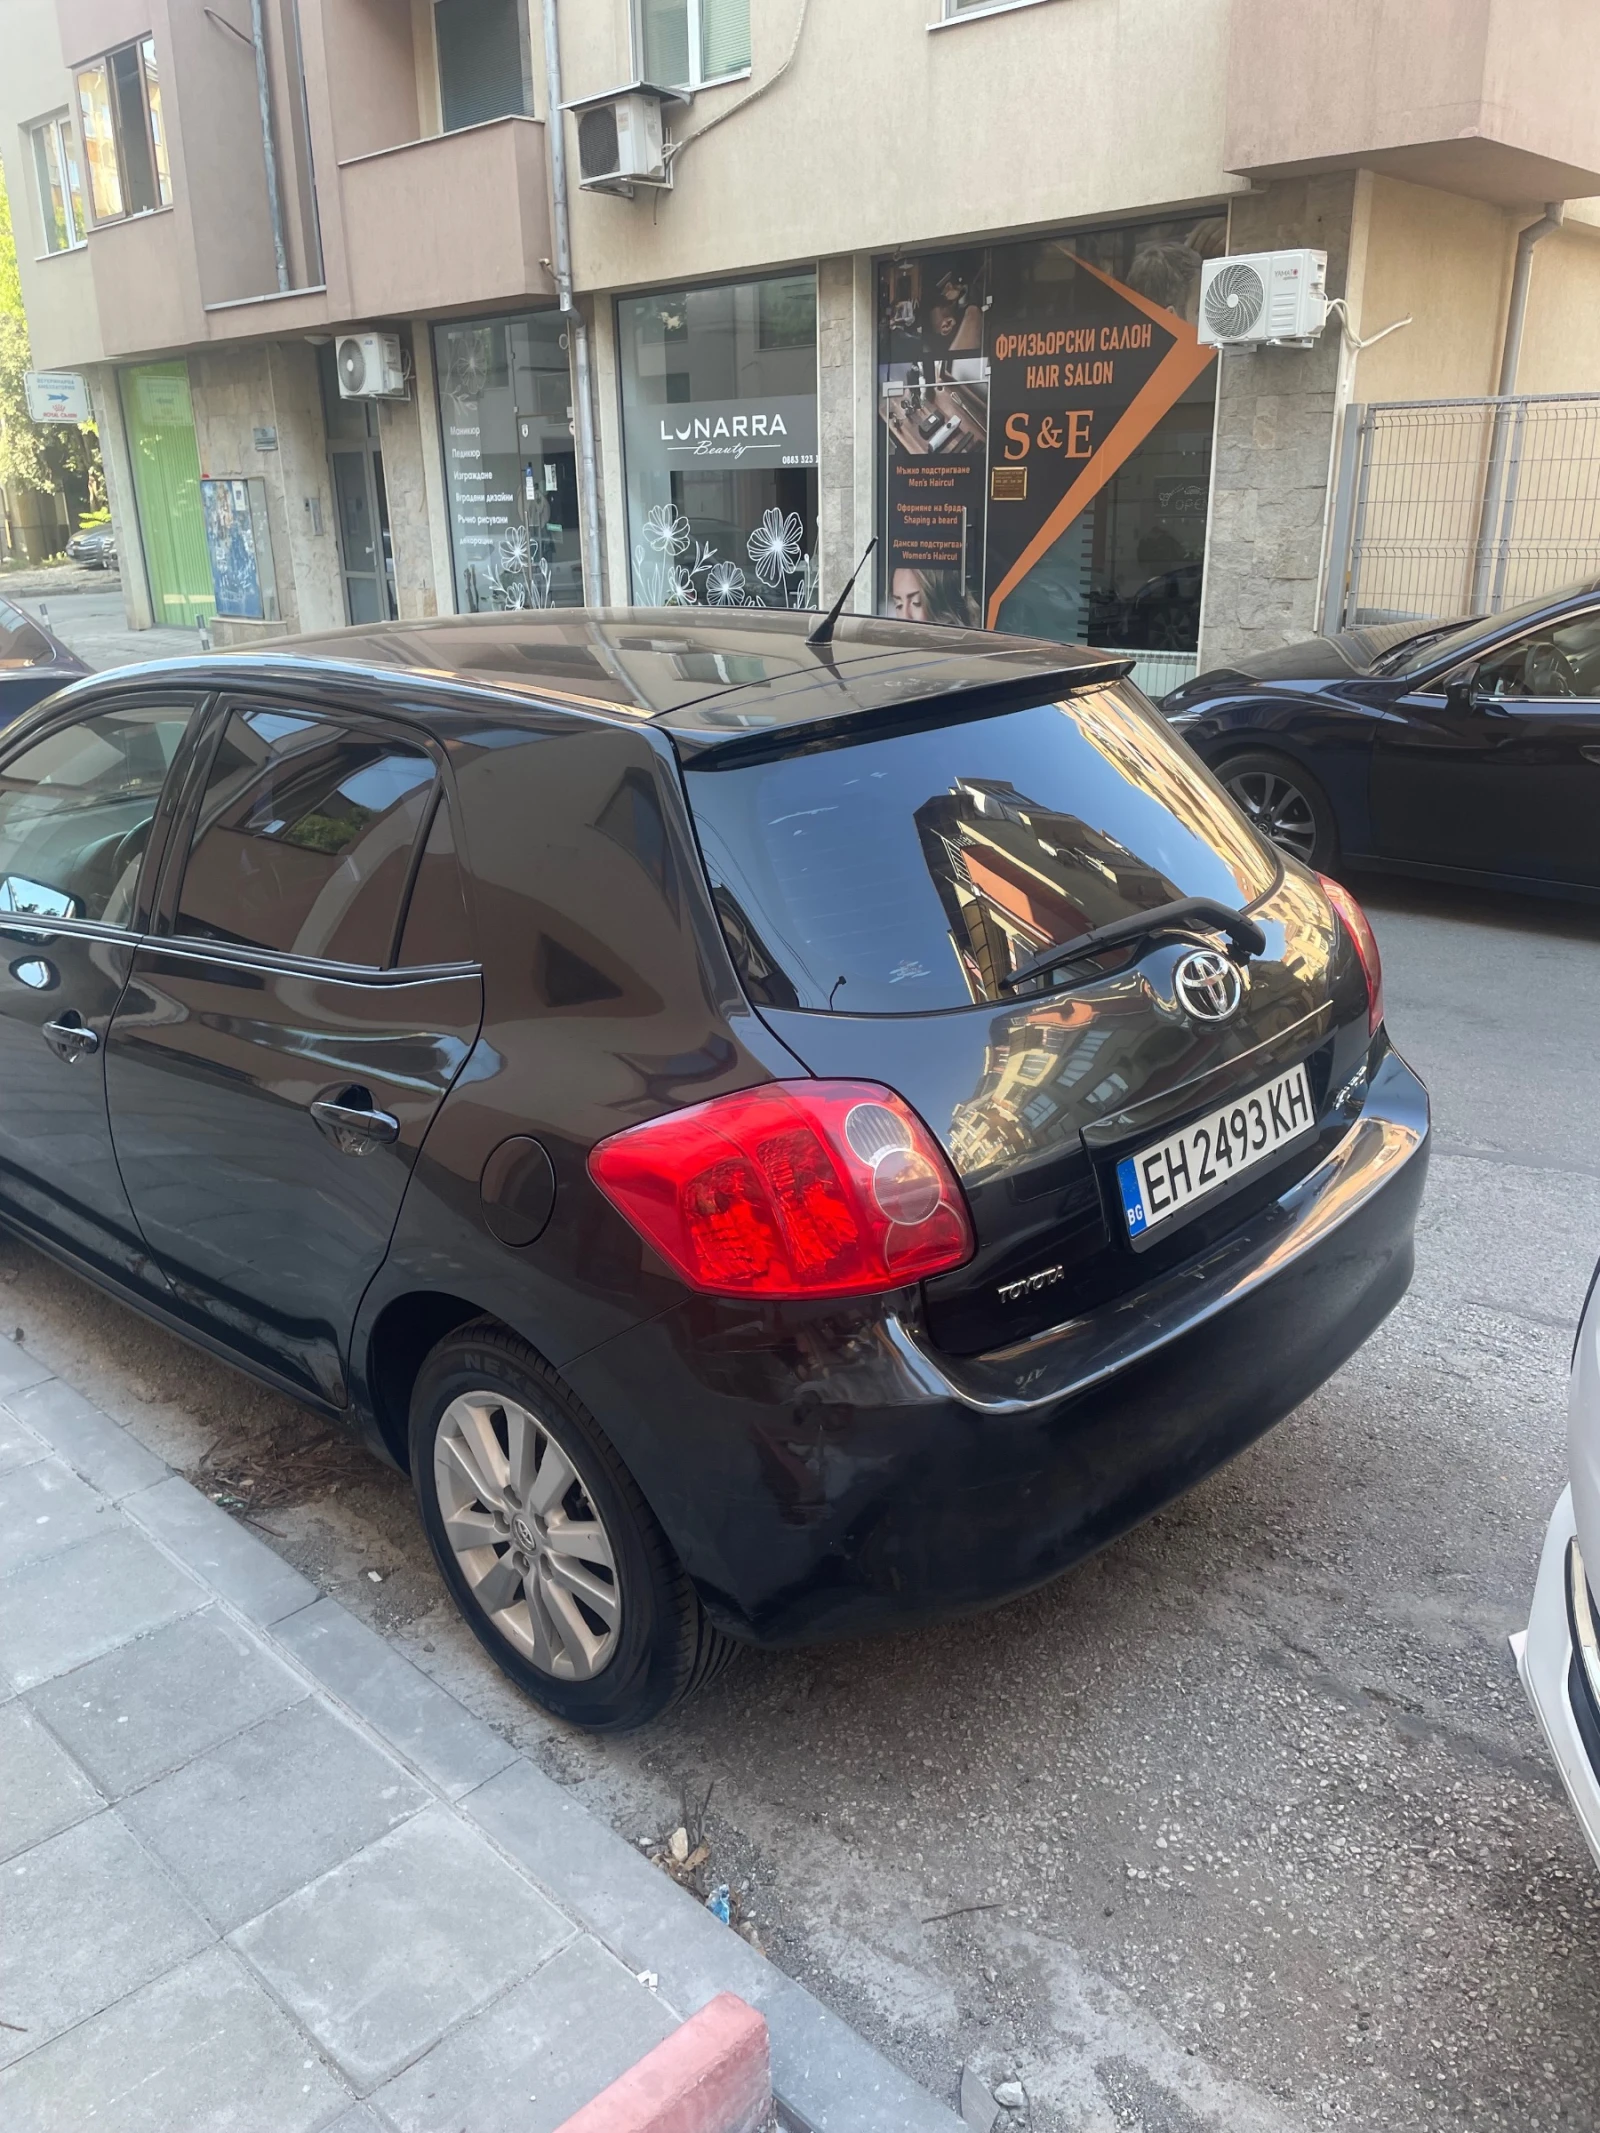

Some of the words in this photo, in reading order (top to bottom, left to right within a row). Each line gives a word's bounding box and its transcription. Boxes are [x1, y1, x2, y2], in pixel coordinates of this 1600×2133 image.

[995, 328, 1096, 361] ФРИЗЬОРСКИ
[1100, 324, 1152, 351] САЛОН
[1026, 364, 1060, 389] HAIR
[1064, 361, 1114, 387] SALON
[450, 426, 480, 437] Маникюр
[660, 413, 788, 441] LUNARRA
[452, 448, 481, 459] Педикюр
[690, 440, 752, 460] Beauty
[453, 471, 493, 482] Изграждане
[896, 466, 920, 475] Мъжко
[921, 466, 971, 476] подстригване
[929, 478, 955, 487] Haircut
[455, 492, 485, 504] Вградени
[486, 491, 514, 502] дизайни
[457, 514, 477, 524] Ръчно
[477, 516, 509, 526] рисувани
[903, 515, 931, 526] Shaping
[938, 516, 958, 525] beard
[919, 540, 967, 550] подстригван
[932, 551, 958, 561] Haircut
[1126, 1204, 1143, 1226] BG
[996, 1265, 1065, 1304] TOYOTA
